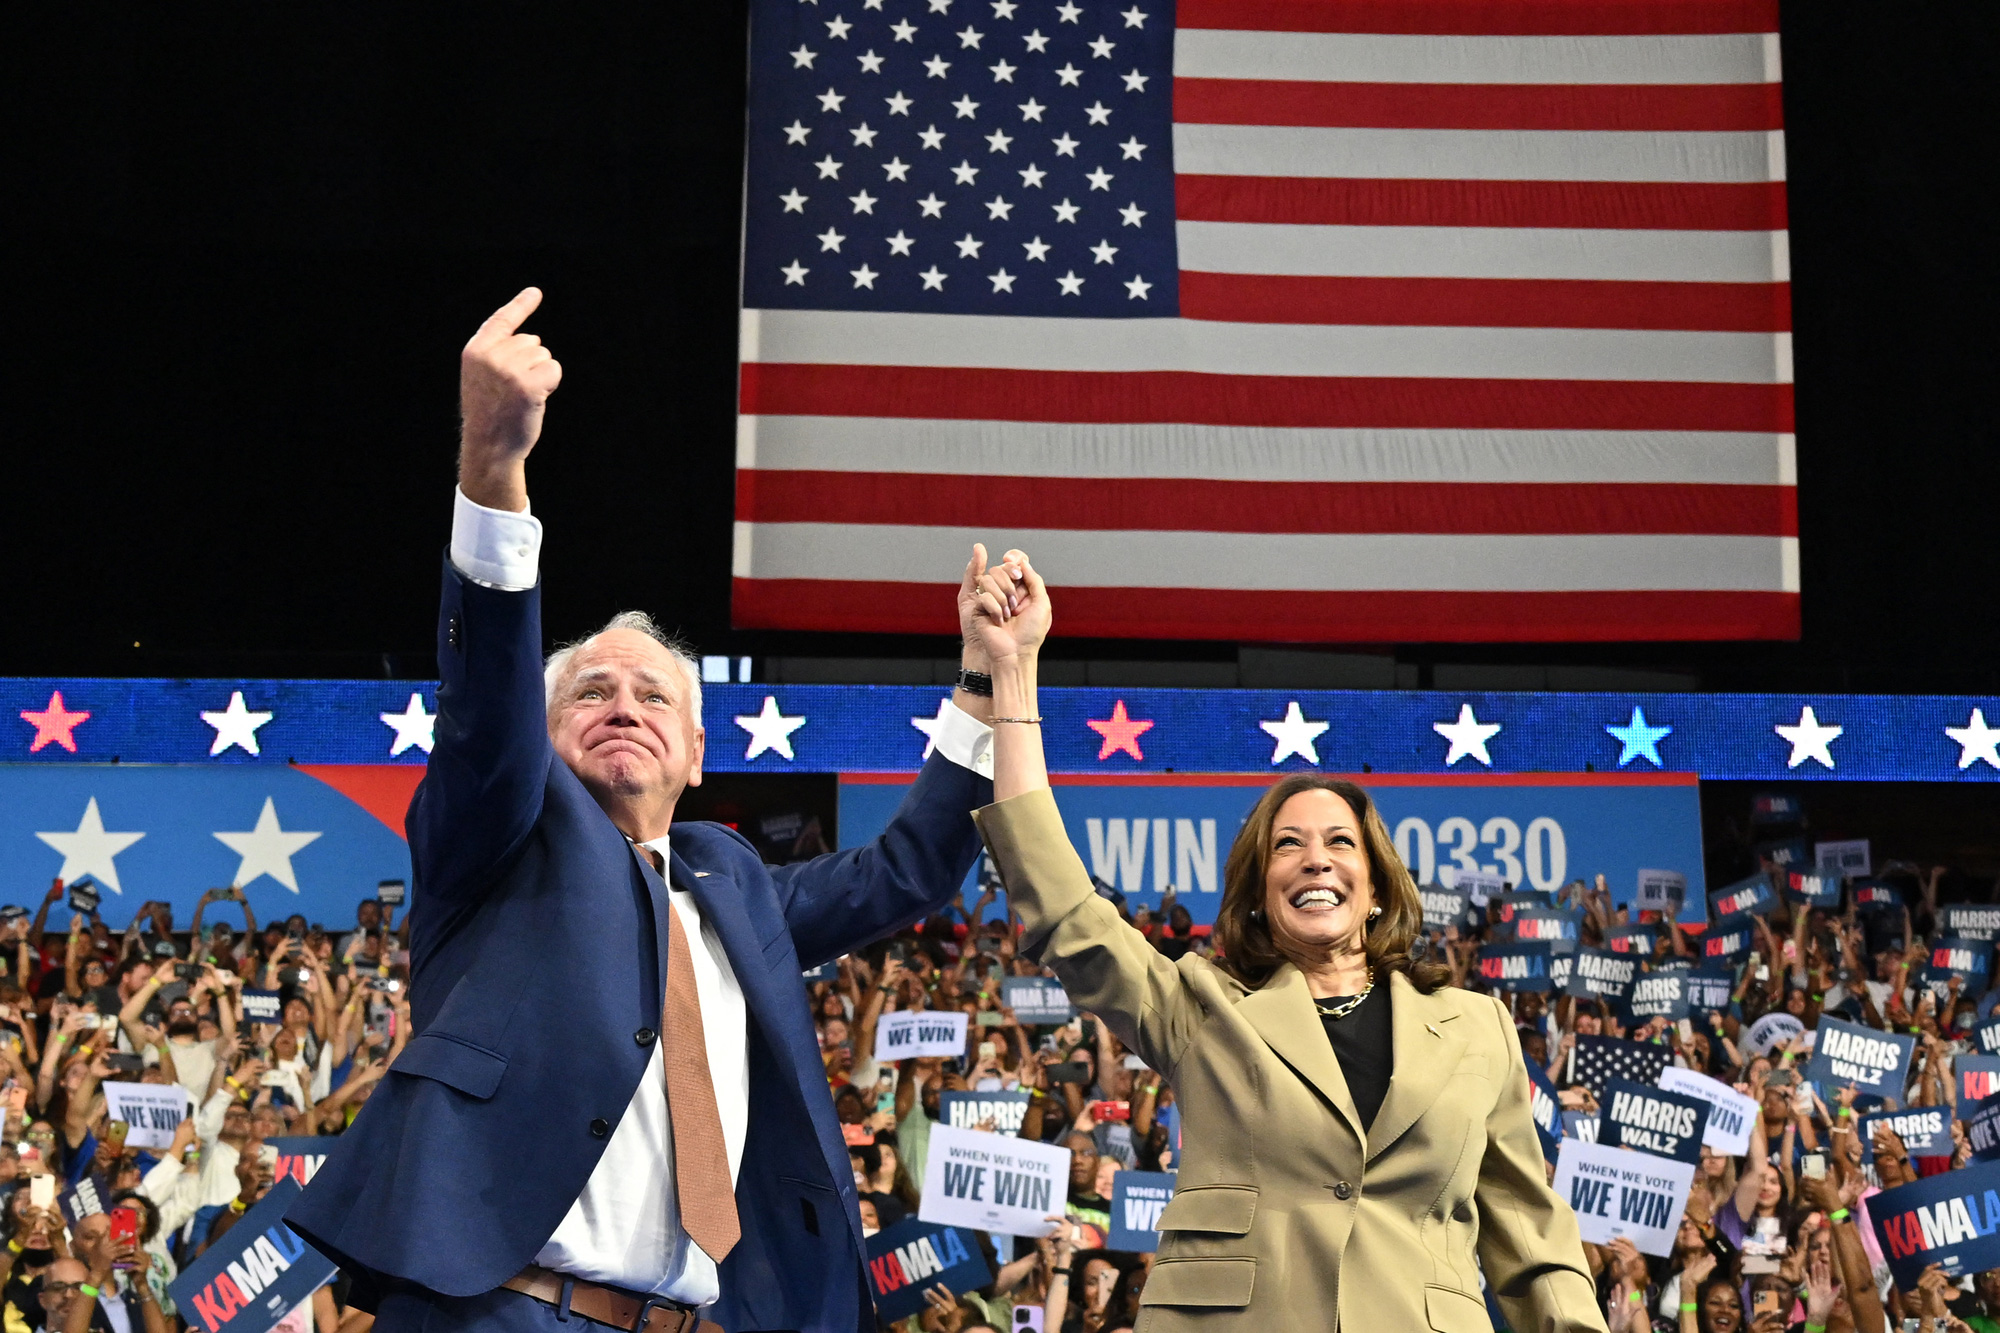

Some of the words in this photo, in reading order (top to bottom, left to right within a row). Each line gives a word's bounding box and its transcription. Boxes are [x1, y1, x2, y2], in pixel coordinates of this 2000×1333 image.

[1085, 818, 1217, 893] WIN
[1717, 882, 1770, 916] KAMALA
[1518, 918, 1577, 940] KAMALA
[1950, 908, 2000, 930] HARRIS
[1481, 955, 1545, 979] KAMALA
[1577, 953, 1635, 984] HARRIS
[1932, 948, 1986, 974] KAMALA
[1585, 978, 1625, 997] WALZ
[1631, 1001, 1672, 1016] WALZ
[888, 1027, 912, 1046] WE
[919, 1026, 955, 1042] WIN
[1821, 1028, 1901, 1071] HARRIS
[1831, 1058, 1883, 1085] WALZ
[119, 1104, 148, 1129] WE
[149, 1107, 182, 1132] WIN
[1610, 1091, 1698, 1139] HARRIS
[1621, 1125, 1678, 1155] WALZ
[949, 1147, 990, 1162] WHEN
[993, 1153, 1014, 1167] WE
[1018, 1158, 1050, 1174] VOTE
[944, 1161, 987, 1202] WE
[994, 1169, 1052, 1212] WIN
[1578, 1161, 1618, 1178] WHEN
[1621, 1170, 1642, 1183] WE
[1645, 1175, 1675, 1191] VOTE
[1126, 1186, 1166, 1200] WHEN
[1571, 1175, 1615, 1218] WE
[1620, 1185, 1674, 1230] WIN
[869, 1227, 970, 1296] KAMALA
